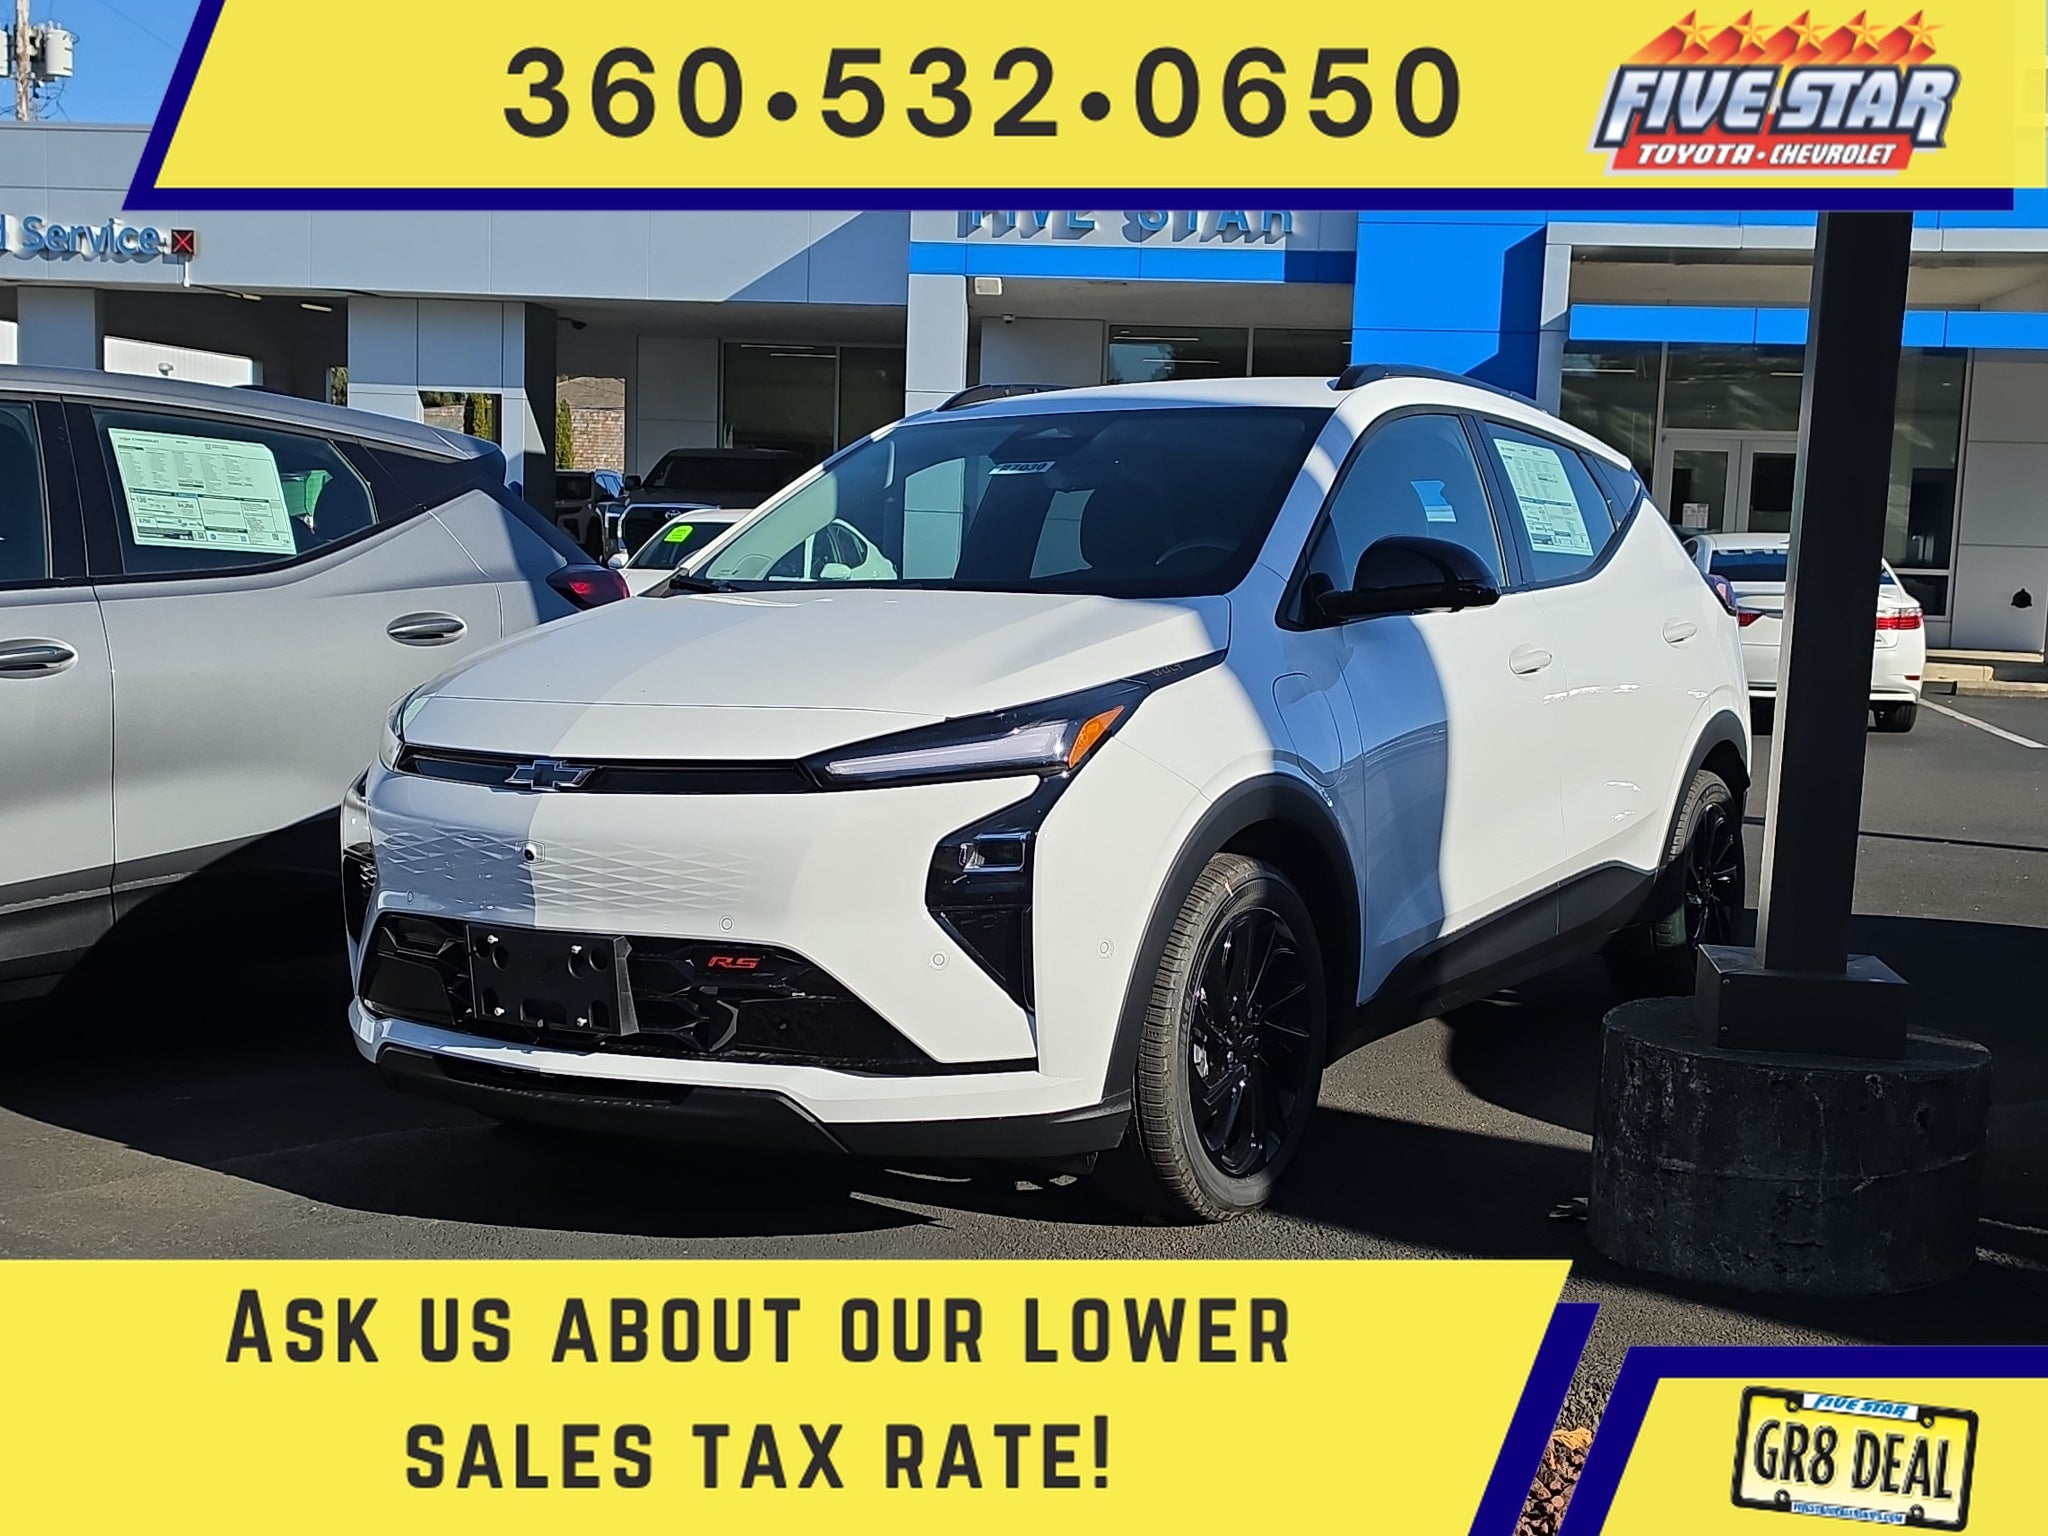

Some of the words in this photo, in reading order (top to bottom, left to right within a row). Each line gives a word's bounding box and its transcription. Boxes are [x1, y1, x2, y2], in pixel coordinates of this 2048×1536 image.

[22, 215, 161, 254] Service
[1151, 664, 1185, 677] BOLT
[707, 956, 761, 969] RS
